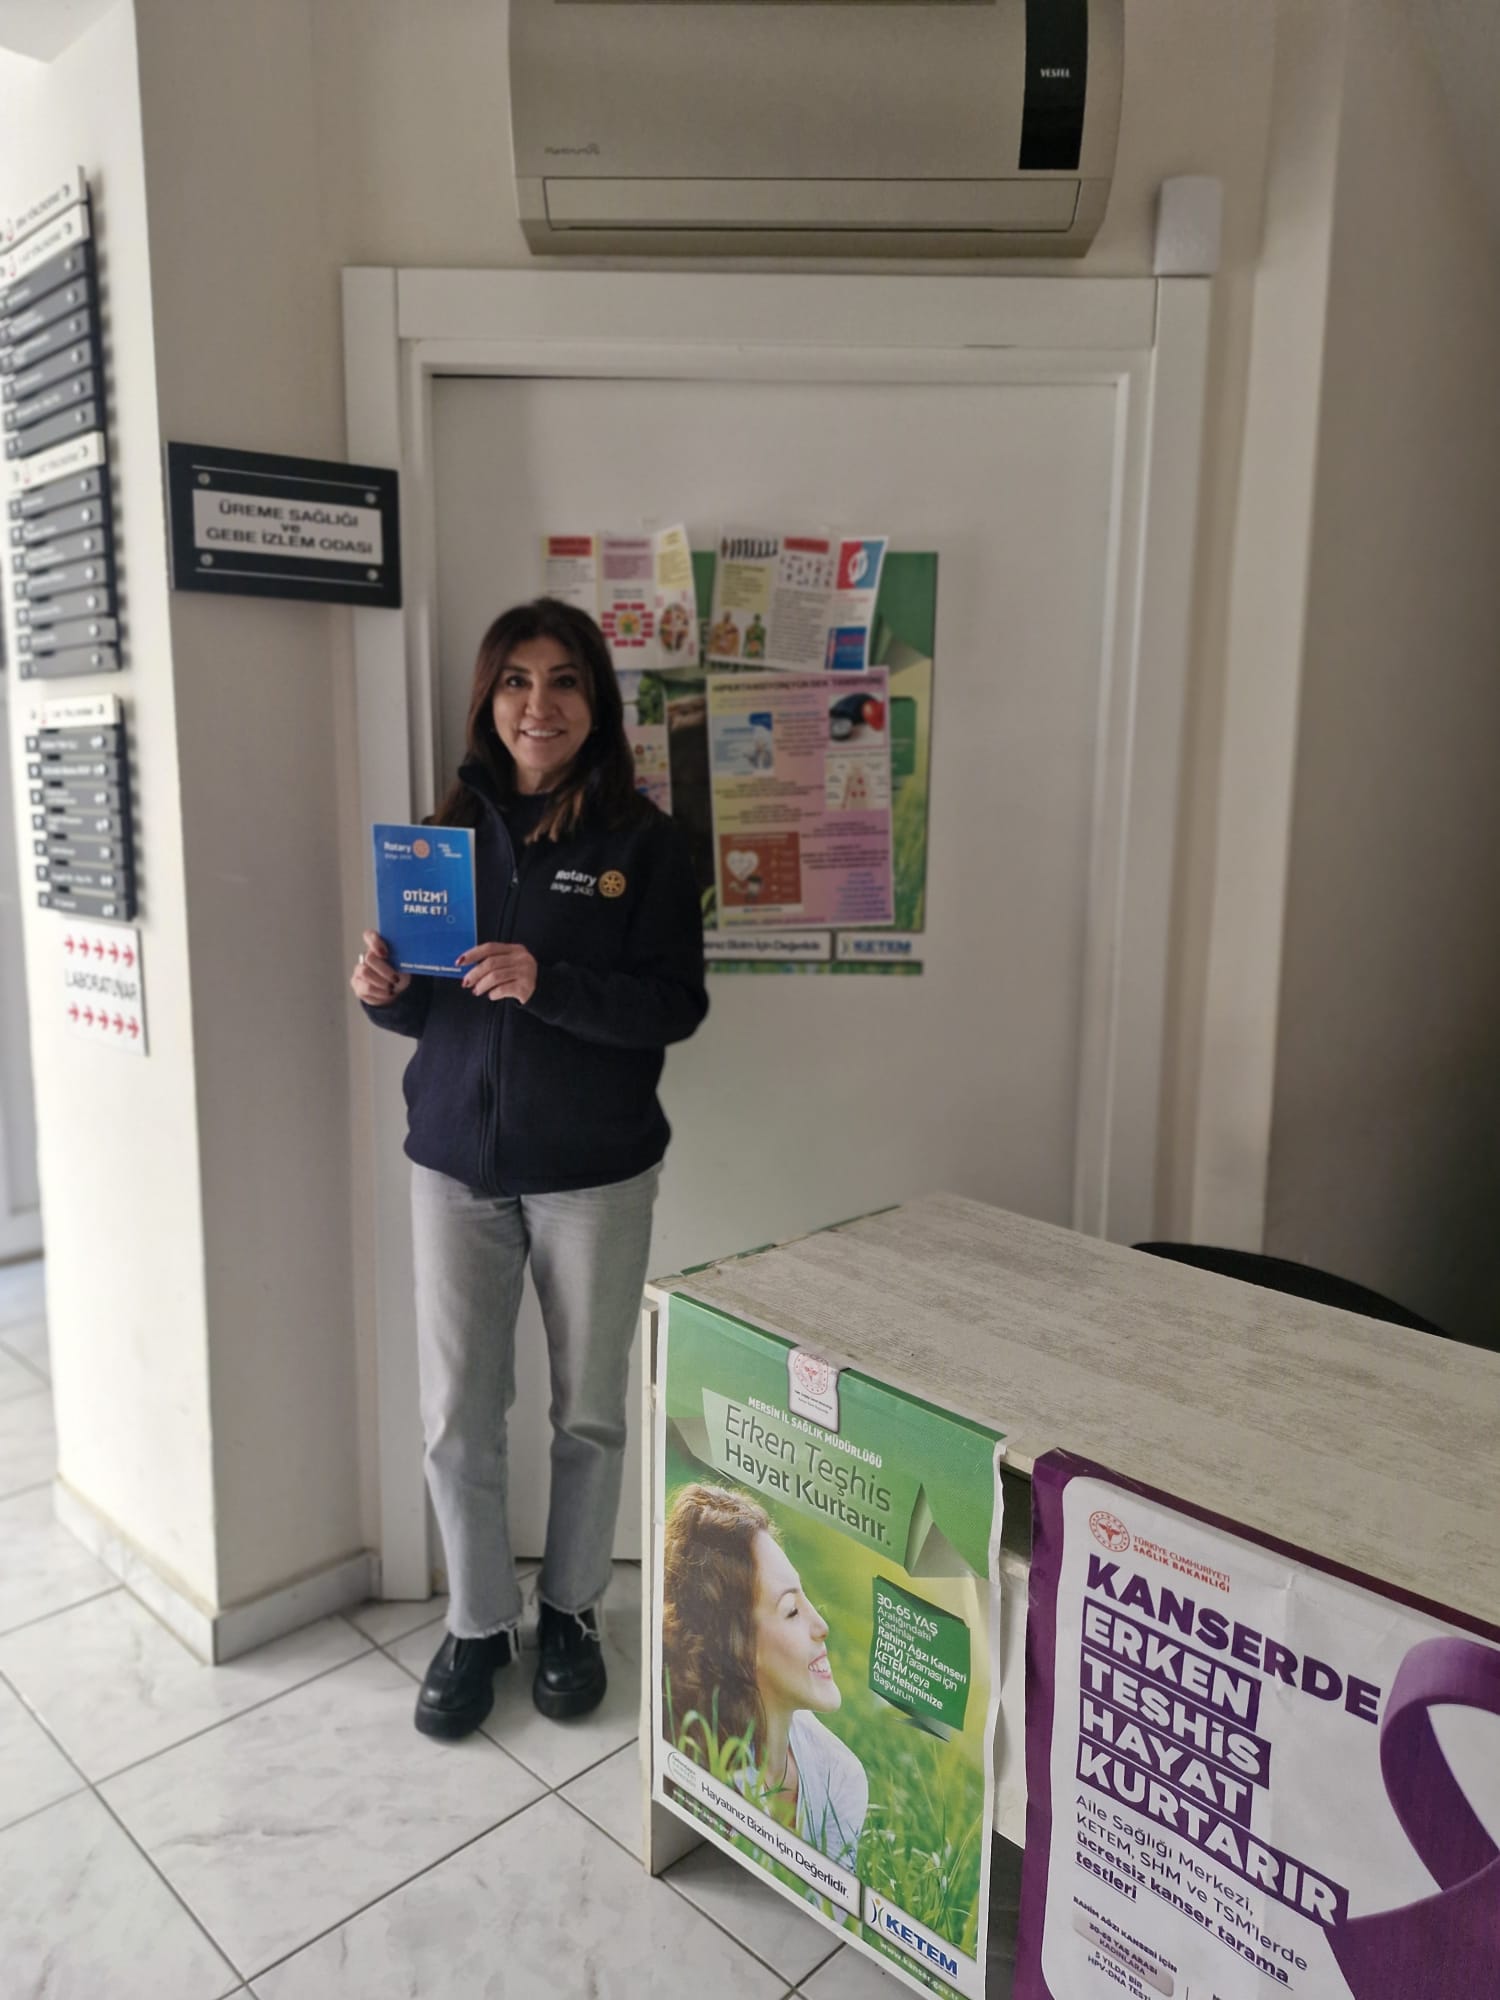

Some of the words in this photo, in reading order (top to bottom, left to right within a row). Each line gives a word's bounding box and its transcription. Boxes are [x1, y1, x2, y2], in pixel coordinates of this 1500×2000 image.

[1040, 68, 1070, 78] VESTEL
[219, 500, 284, 520] ÜREME
[289, 507, 359, 527] SAĞLIĞI
[281, 524, 301, 533] ve
[206, 527, 256, 544] GEBE
[262, 529, 315, 548] İZLEM
[319, 538, 373, 554] ODASI
[555, 869, 597, 887] Rotary
[403, 904, 428, 916] FARK
[749, 1396, 780, 1419] MERSİN
[782, 1411, 790, 1424] İL
[791, 1417, 824, 1440] SAĞLIK
[824, 1432, 883, 1468] MÜDÜRLÜĞÜ
[726, 1404, 796, 1464] Erken
[805, 1441, 892, 1512] Teşhis
[726, 1438, 790, 1493] Hayat
[796, 1474, 891, 1546] Kurtarır.
[1133, 1544, 1169, 1566] SAĞLIK
[1172, 1562, 1230, 1593] BAKANLIĞI
[1134, 1535, 1168, 1556] TÜRKİYE
[1169, 1551, 1230, 1583] CUMHURİYETİ
[877, 1593, 911, 1619] 30-65
[913, 1612, 938, 1637] YAŞ
[877, 1606, 932, 1642] Aralığındaki
[878, 1616, 915, 1642] Kadınlar
[876, 1637, 904, 1662] (HPV)
[906, 1654, 942, 1682] Taraması
[878, 1627, 907, 1649] Rahim
[909, 1643, 929, 1661] Ağzı
[931, 1655, 967, 1684] Kanseri
[1085, 1603, 1251, 1720] ERKEN
[1086, 1553, 1382, 1726] KANSERDE
[874, 1661, 891, 1678] Aile
[892, 1673, 943, 1710] Hekiminize
[875, 1648, 908, 1675] KETEM
[908, 1669, 930, 1689] veya
[1083, 1698, 1248, 1816] HAYAT
[701, 1782, 746, 1823] Hayatınız
[747, 1816, 774, 1845] Bizim
[776, 1833, 794, 1858] İçin
[795, 1851, 849, 1898] Değerlidir.
[1076, 1795, 1107, 1820] Aile
[1112, 1815, 1172, 1858] Sağlığı
[1179, 1852, 1253, 1916] Merkezi,
[1079, 1742, 1338, 1928] KURTARIR
[1076, 1851, 1137, 1900] testleri
[1077, 1812, 1135, 1860] KETEM,
[1140, 1851, 1181, 1885] SHM
[1187, 1880, 1208, 1903] ve
[1213, 1897, 1308, 1971] TSM'lerde
[1077, 1830, 1146, 1884] ücretsiz
[1150, 1876, 1213, 1928] kanser
[1218, 1925, 1289, 1984] tarama
[886, 1913, 958, 1976] KETEM
[1099, 1938, 1146, 1976] KADINLARA
[1131, 1953, 1158, 1975] ARASI
[1087, 1955, 1127, 1988] HPV-DNA
[1095, 1950, 1101, 1960] 5
[1102, 1955, 1127, 1978] YILDA
[1128, 1973, 1143, 1990] BİR
